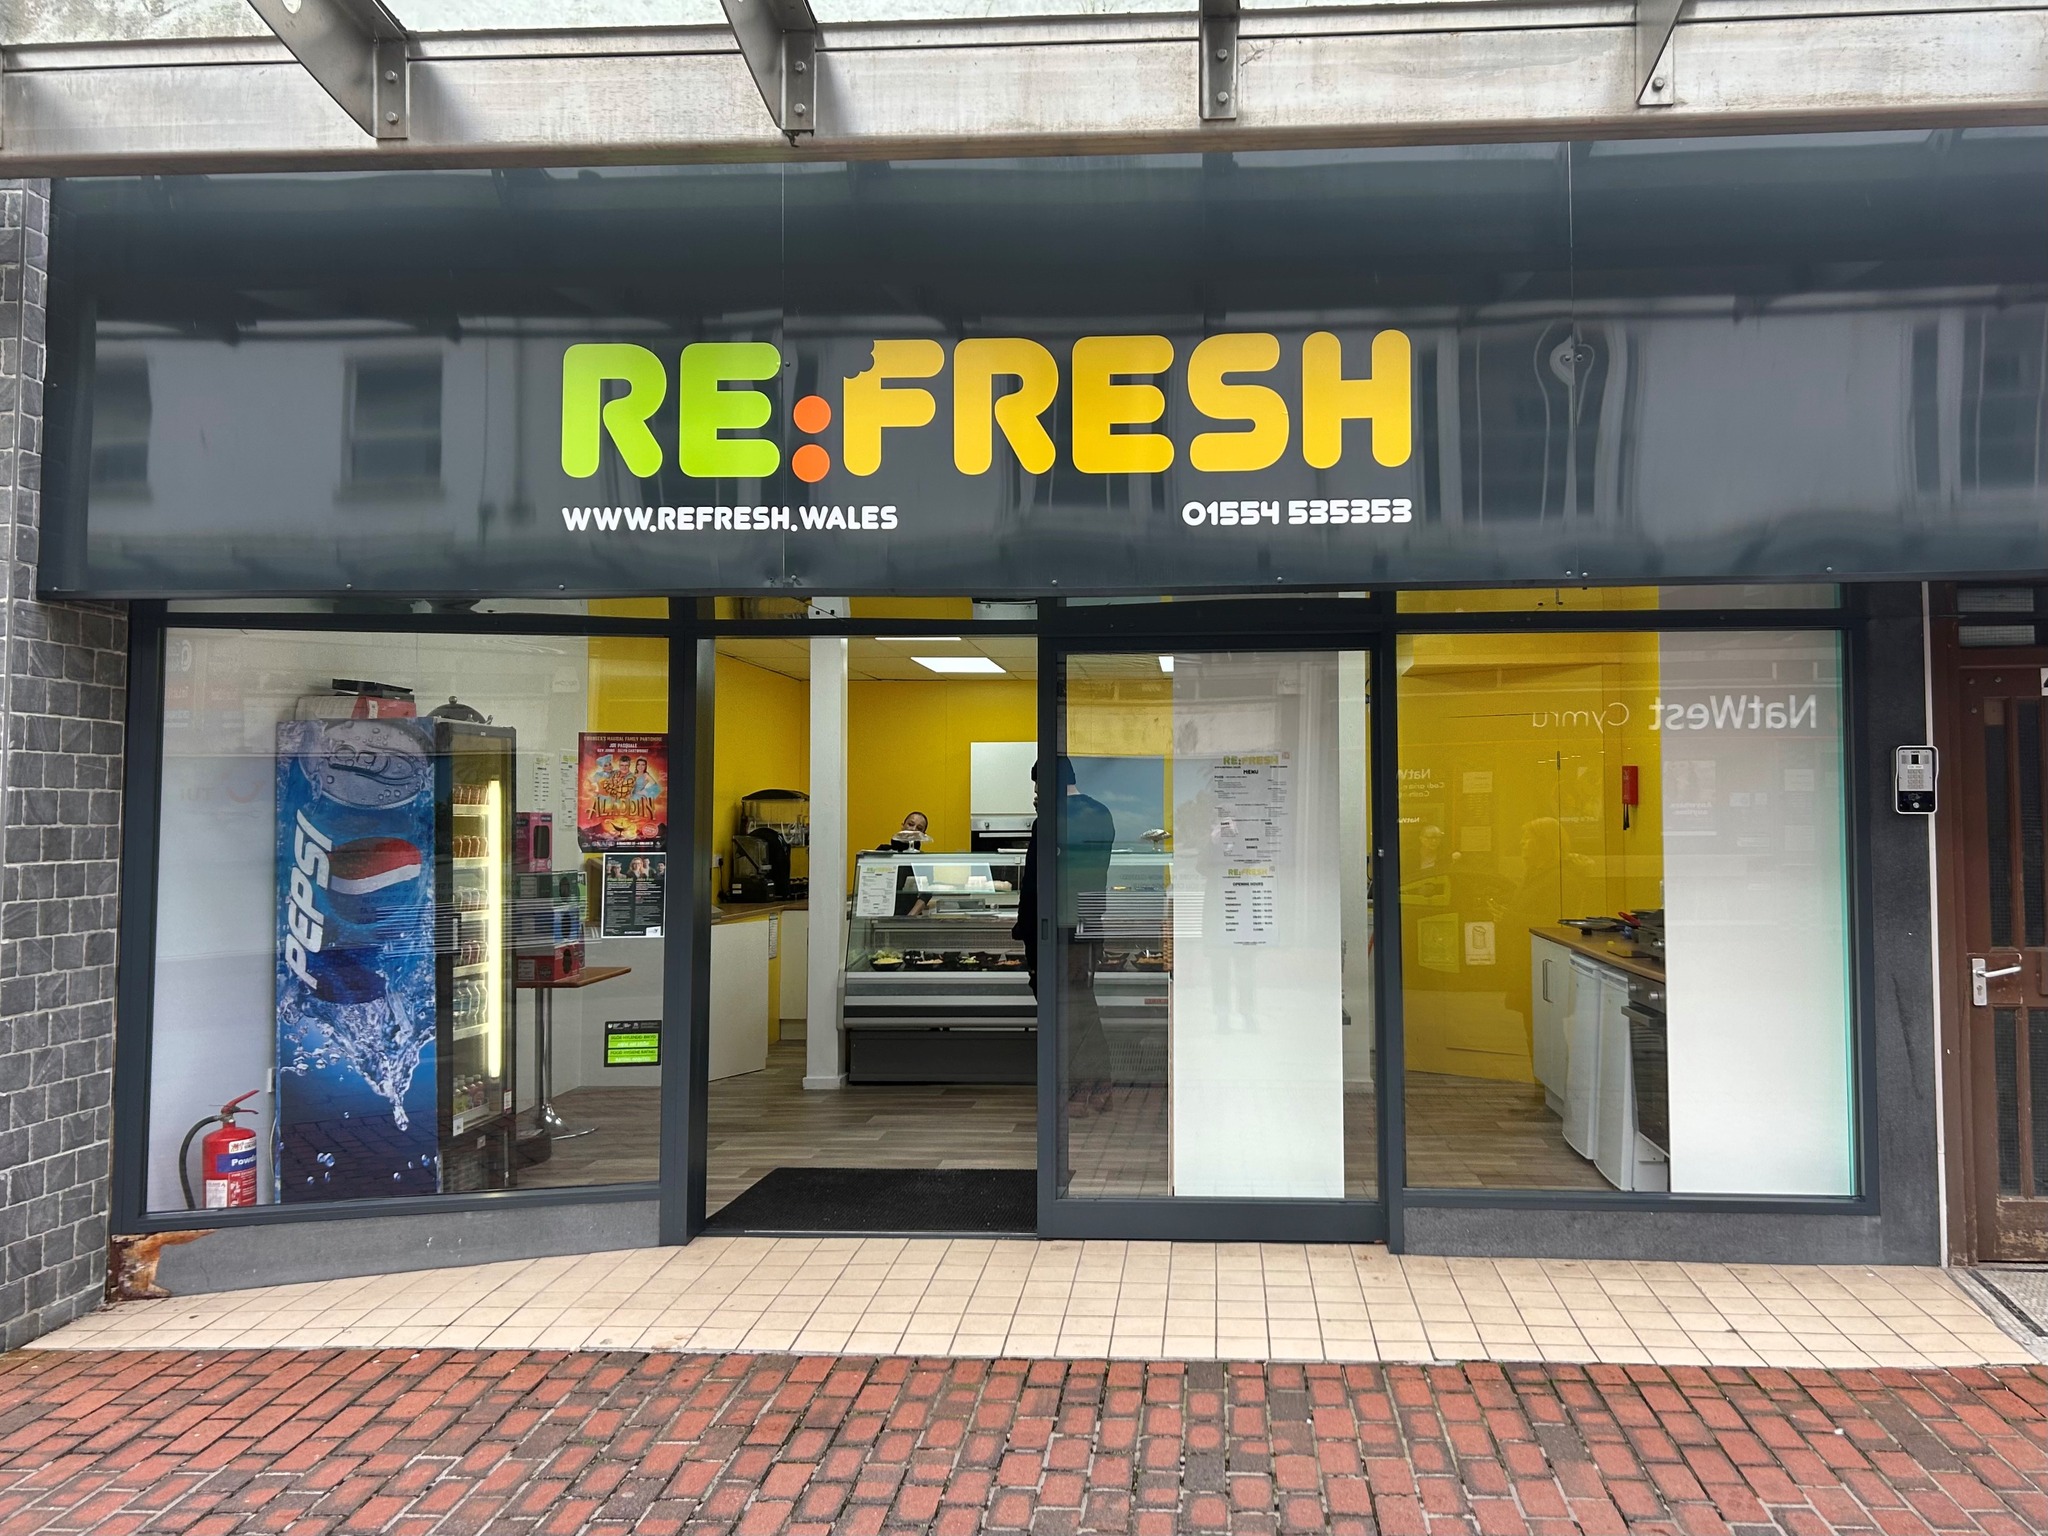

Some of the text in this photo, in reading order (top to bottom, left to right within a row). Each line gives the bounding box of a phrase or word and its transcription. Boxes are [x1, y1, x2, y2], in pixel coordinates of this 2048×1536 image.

[561, 329, 1413, 483] RE:FRESH
[561, 505, 899, 532] WWW.REFRESH.WALES
[1181, 498, 1413, 527] 01554 535353
[585, 796, 657, 821] ALADDIN
[285, 809, 333, 990] PEPSI
